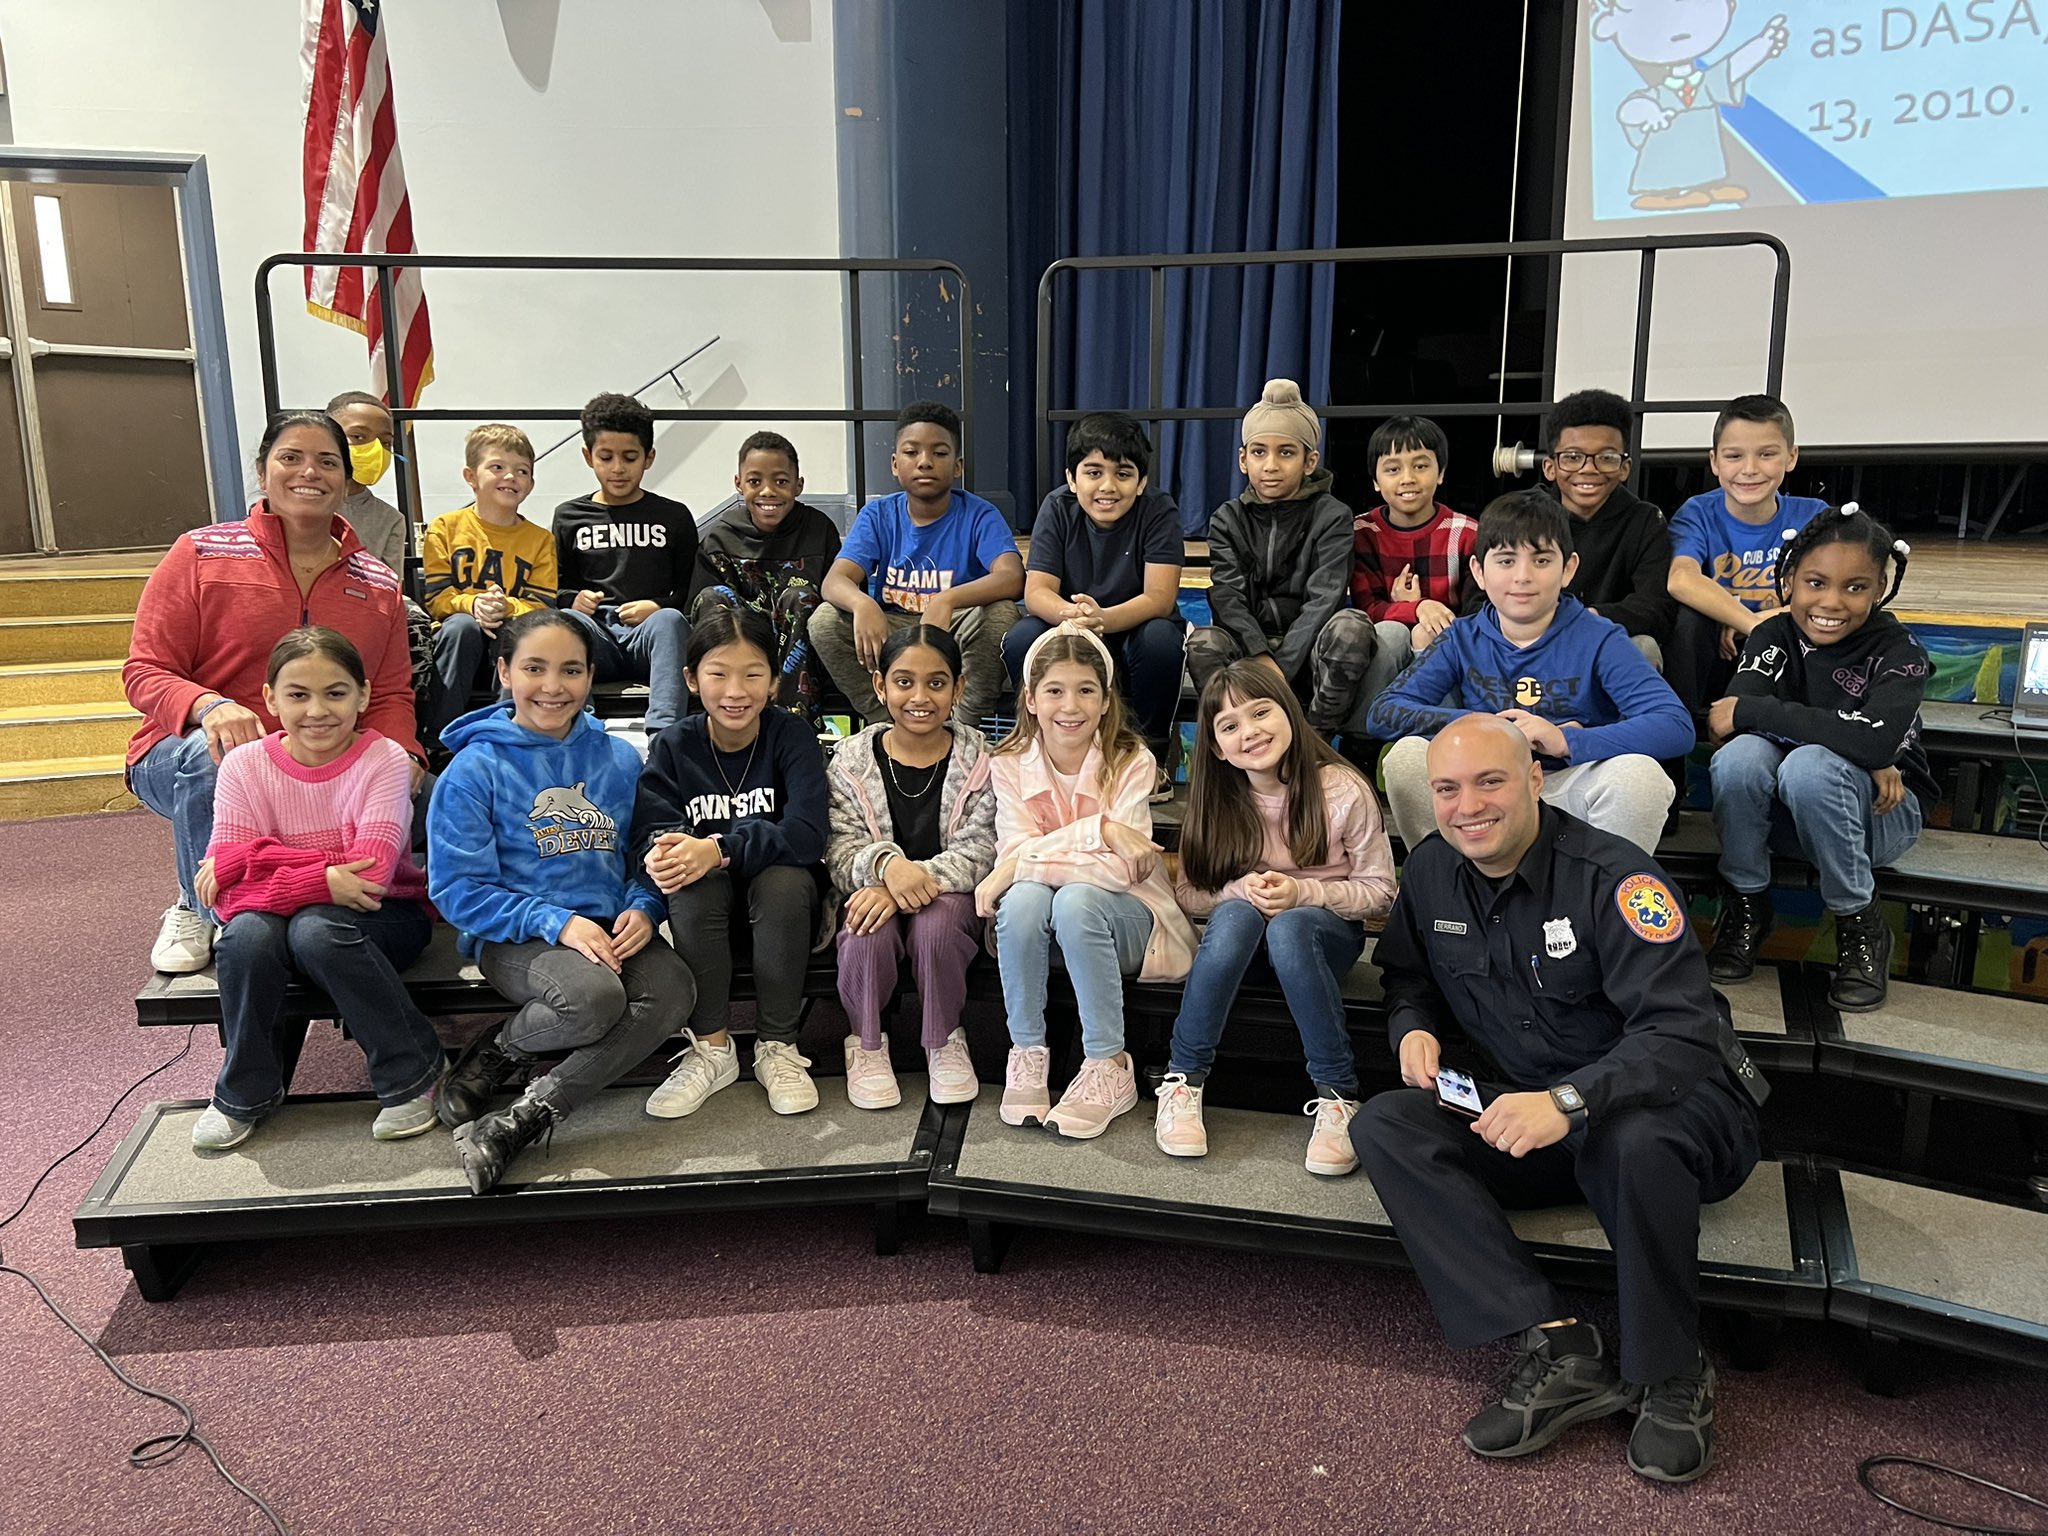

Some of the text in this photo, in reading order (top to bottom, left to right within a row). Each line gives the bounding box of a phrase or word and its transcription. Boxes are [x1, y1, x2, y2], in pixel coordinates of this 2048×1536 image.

[1810, 23, 1862, 58] as
[1808, 84, 2030, 142] 13, 2010.
[575, 522, 667, 550] GENIUS
[1743, 549, 1764, 565] CUB
[1621, 876, 1656, 894] POLICE
[1630, 916, 1654, 938] COUNTY
